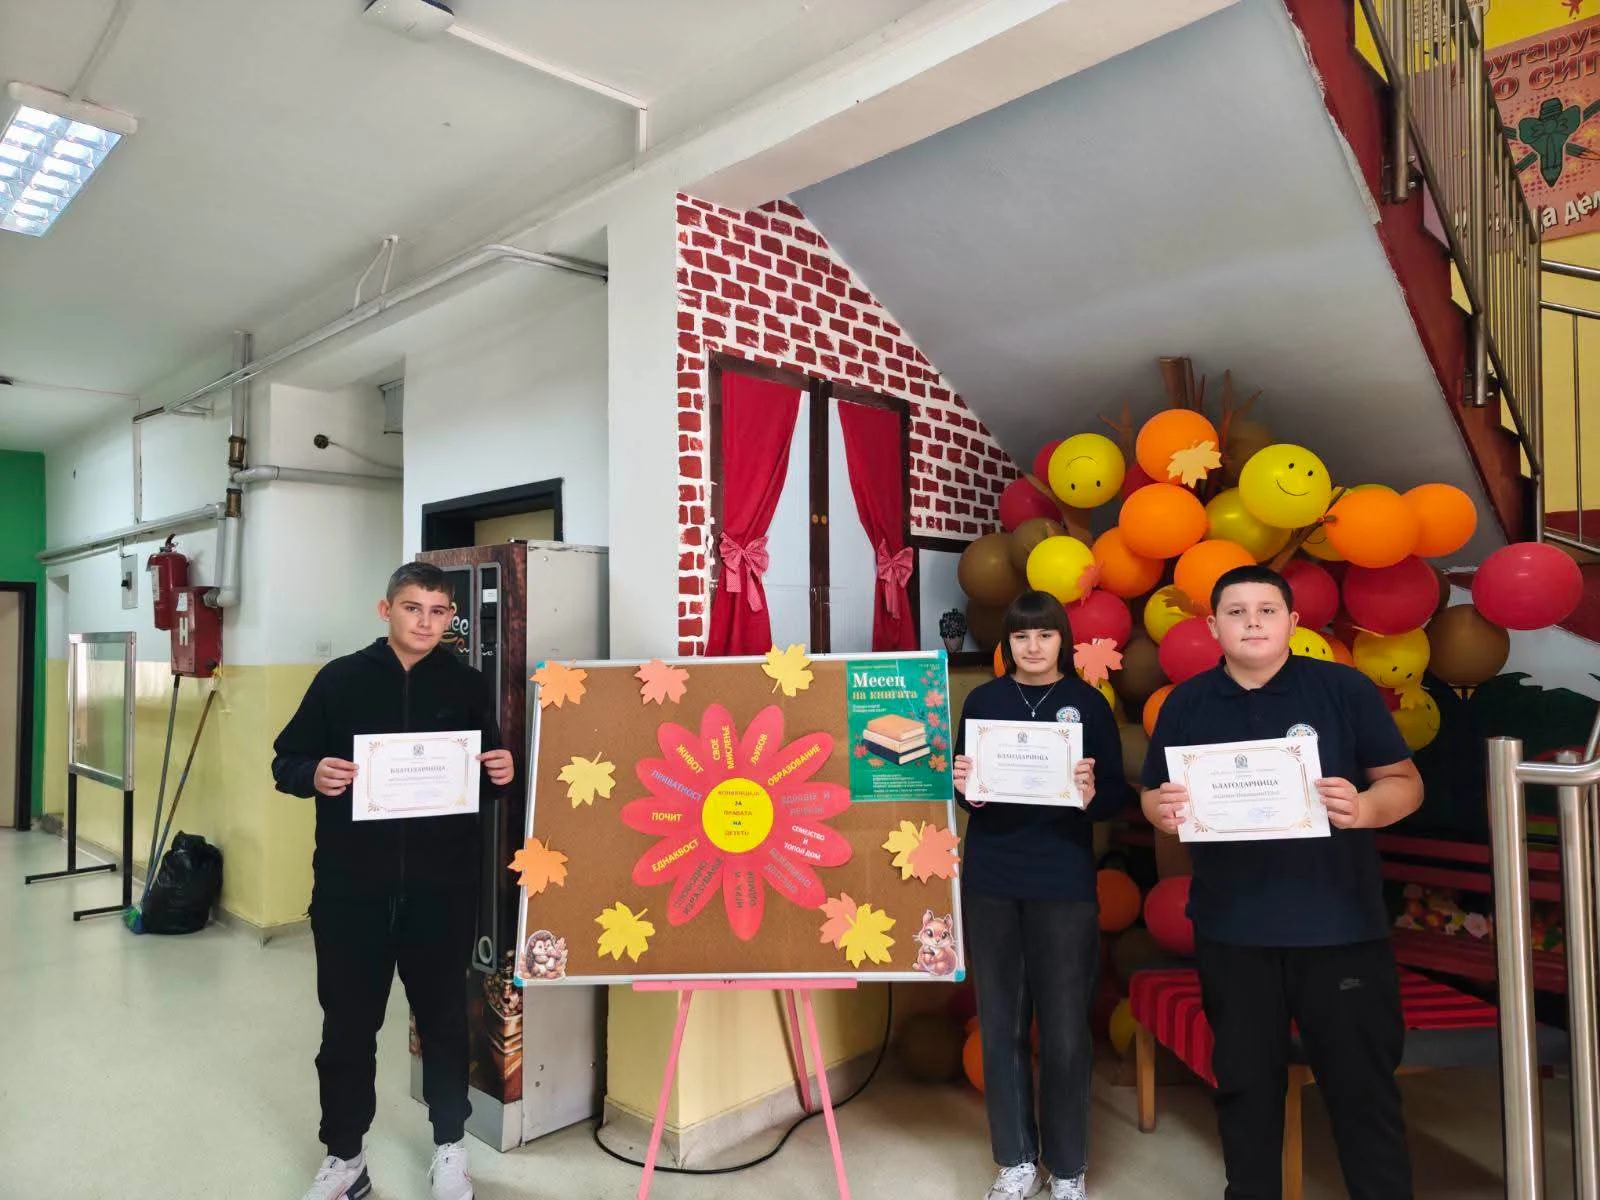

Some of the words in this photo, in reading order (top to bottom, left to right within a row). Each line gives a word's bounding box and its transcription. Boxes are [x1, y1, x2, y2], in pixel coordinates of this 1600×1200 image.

[853, 672, 906, 689] Месец
[676, 744, 705, 775] ЖИВОТ
[711, 737, 721, 761] СВОЕ
[767, 743, 822, 787] ОБРАЗОВАНИЕ
[651, 811, 683, 823] ПОЧИТ
[652, 838, 701, 873] ЕДНАКВОСТ
